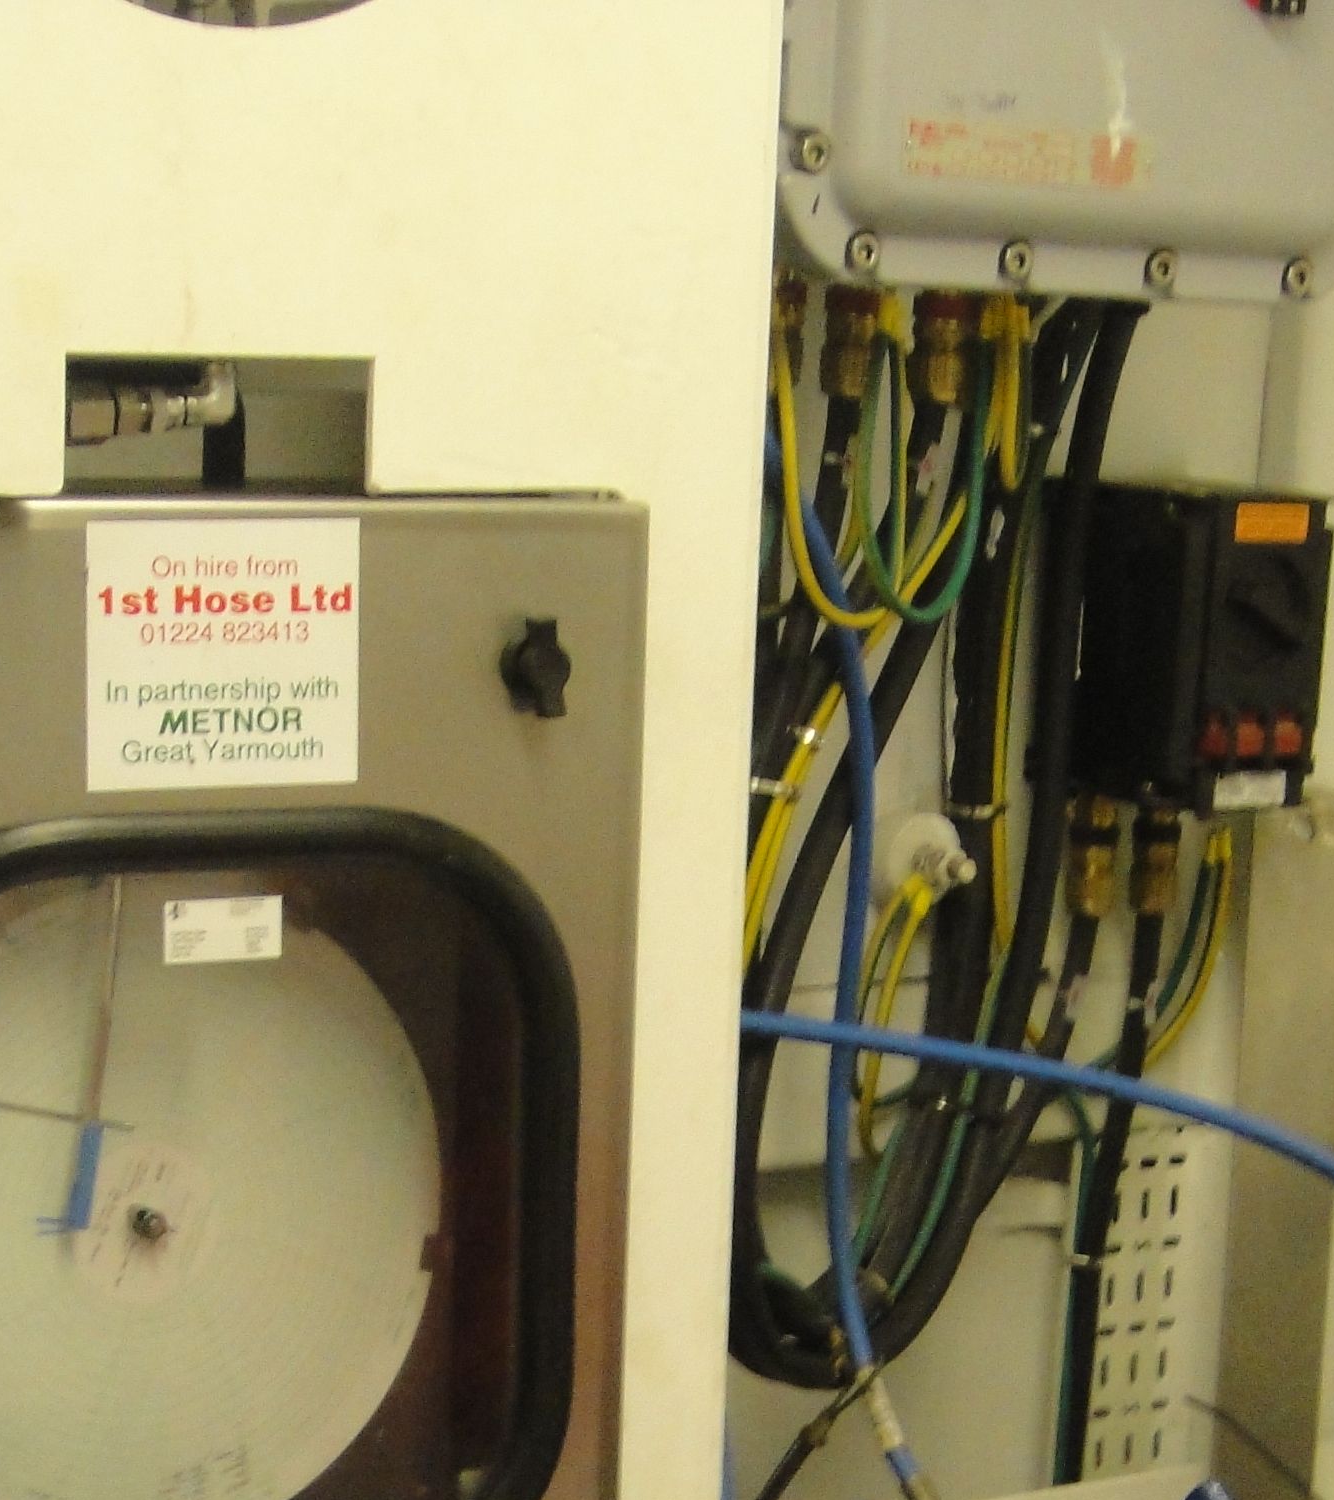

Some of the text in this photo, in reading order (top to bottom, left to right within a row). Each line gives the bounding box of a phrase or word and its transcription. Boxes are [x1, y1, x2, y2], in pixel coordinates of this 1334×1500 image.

[152, 555, 298, 577] On hire from
[97, 582, 353, 615] 1st Hose Ltd
[141, 621, 309, 644] 01224 823413
[107, 676, 338, 706] In partnership with
[159, 707, 302, 735] METNOR
[204, 737, 323, 761] Yarmouth
